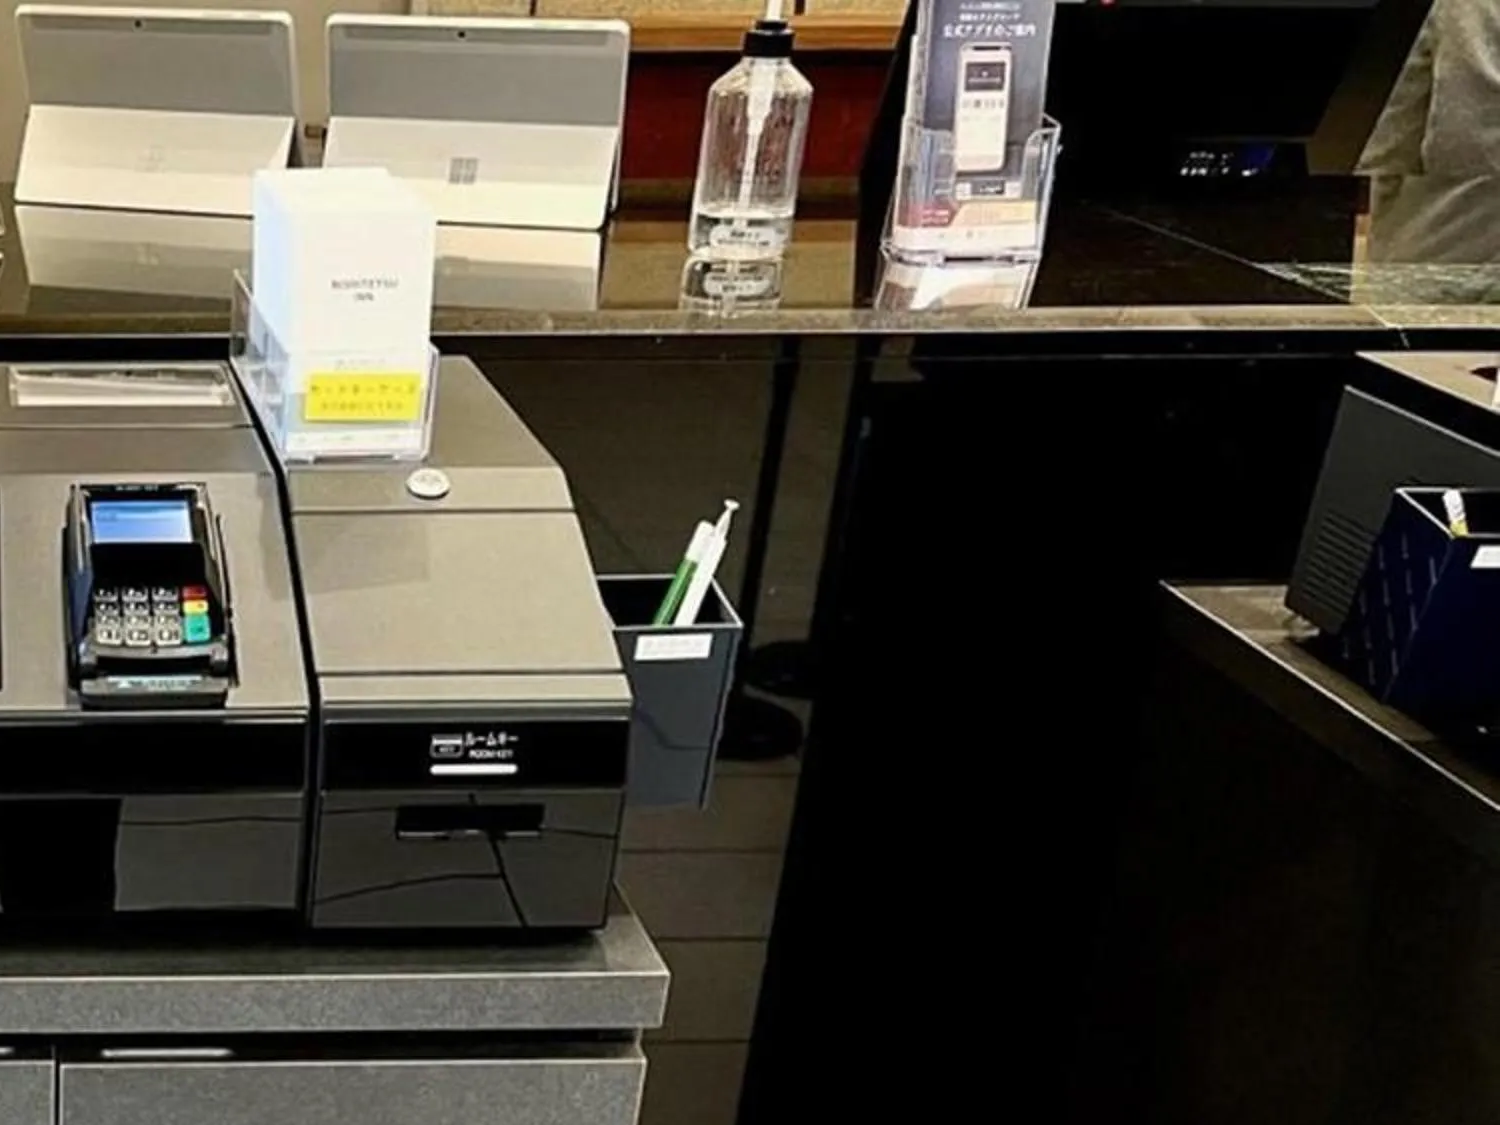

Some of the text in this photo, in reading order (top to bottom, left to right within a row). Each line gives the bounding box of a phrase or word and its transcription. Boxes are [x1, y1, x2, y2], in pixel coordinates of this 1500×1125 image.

[465, 732, 519, 746] ルームキー
